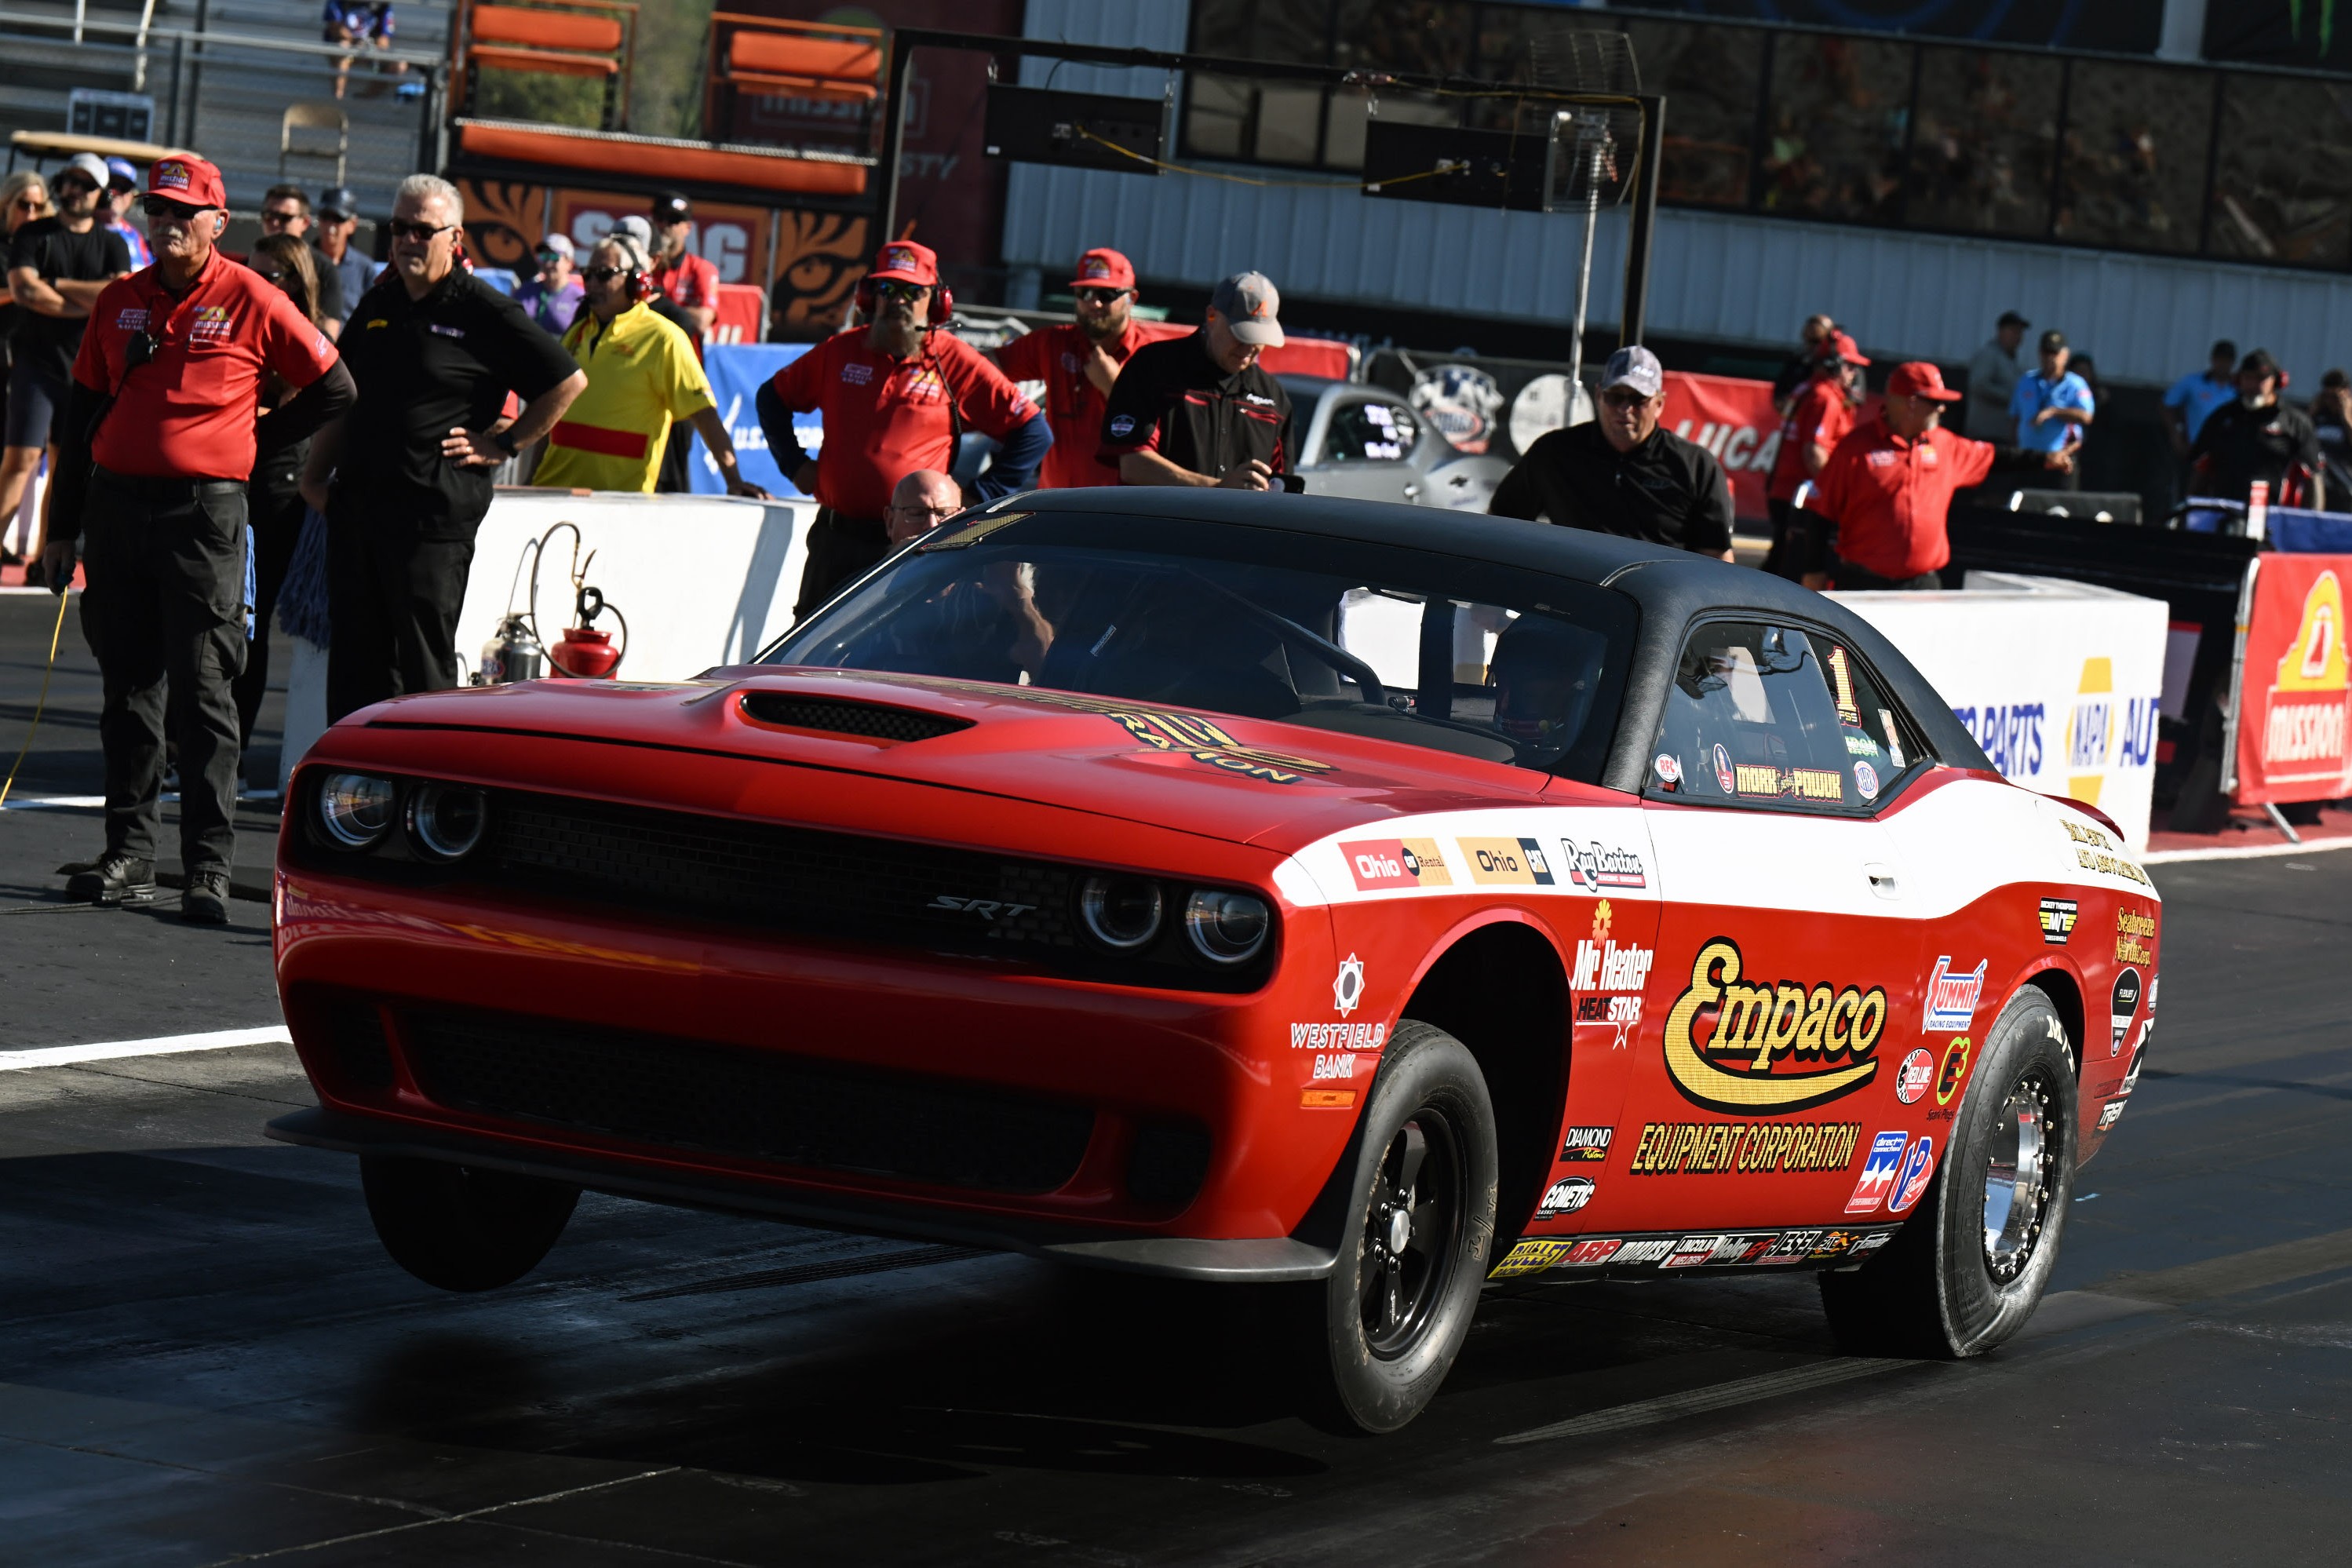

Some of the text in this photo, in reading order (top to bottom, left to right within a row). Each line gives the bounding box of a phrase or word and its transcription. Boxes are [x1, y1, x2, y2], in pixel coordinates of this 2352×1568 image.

[1839, 710, 1858, 722] FSS
[1982, 702, 2044, 777] PARTS
[2073, 703, 2108, 767] NAPA
[1660, 759, 1676, 774] RFC
[1355, 854, 1401, 878] Ohio
[1417, 855, 1445, 867] Rental
[1476, 849, 1548, 873] Ohio CAT
[1561, 838, 1643, 892] Ray Barton
[927, 895, 1037, 920] SRT
[2048, 911, 2069, 932] M/T
[2117, 906, 2155, 939] Seabreeze
[1571, 939, 1654, 991] Mr. Heater
[1924, 957, 1984, 1019] SUMMIT
[1291, 1023, 1385, 1048] WESTFIELD
[1663, 935, 1887, 1117] Empaco
[1945, 1020, 1971, 1029] EQUIPMENT
[1312, 1054, 1356, 1079] BANK
[1906, 1066, 1933, 1083] RED LINE
[1927, 1108, 1955, 1122] Spark Plugs
[1565, 1129, 1612, 1147] DIAMOND
[1630, 1122, 1862, 1176] EQUIPMENT CORPORATION
[1876, 1137, 1900, 1147] direct
[1581, 1147, 1606, 1159] Pistons
[1890, 1136, 1932, 1211] VP
[1541, 1184, 1595, 1209] COMETIC
[1558, 1241, 1621, 1264] ARP
[1676, 1239, 1716, 1253] LINCOLN
[1713, 1237, 1754, 1264] Holley
[1764, 1231, 1822, 1256] JESEL
[1670, 1255, 1705, 1266] WELDERS
